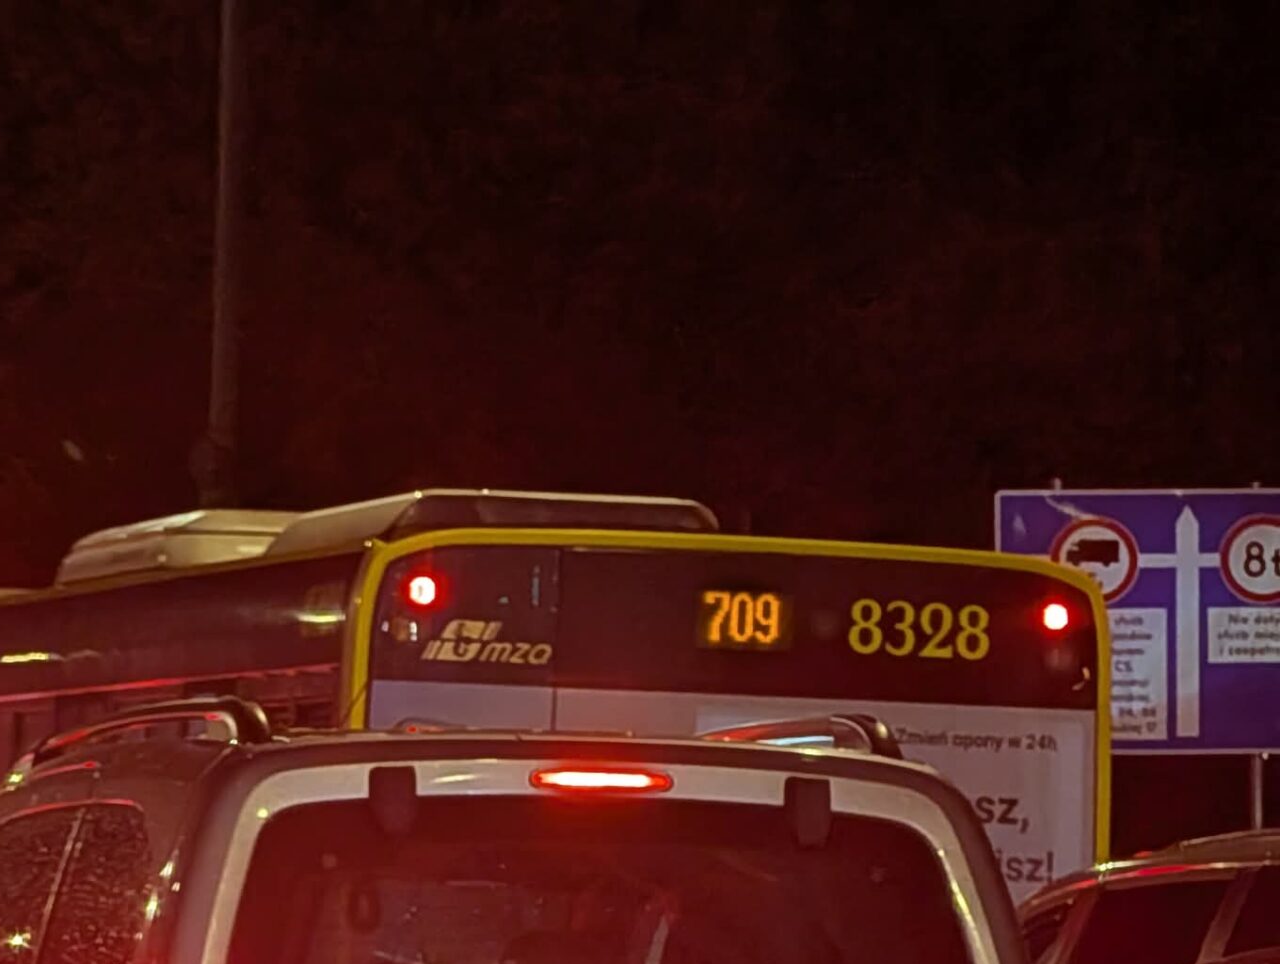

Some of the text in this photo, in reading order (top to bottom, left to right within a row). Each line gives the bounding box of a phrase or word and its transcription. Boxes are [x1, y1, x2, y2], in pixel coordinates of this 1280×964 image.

[704, 592, 780, 643] 709
[848, 599, 990, 660] 8328
[952, 731, 1004, 752] opony
[1008, 735, 1023, 749] w
[1026, 733, 1058, 752] 24h
